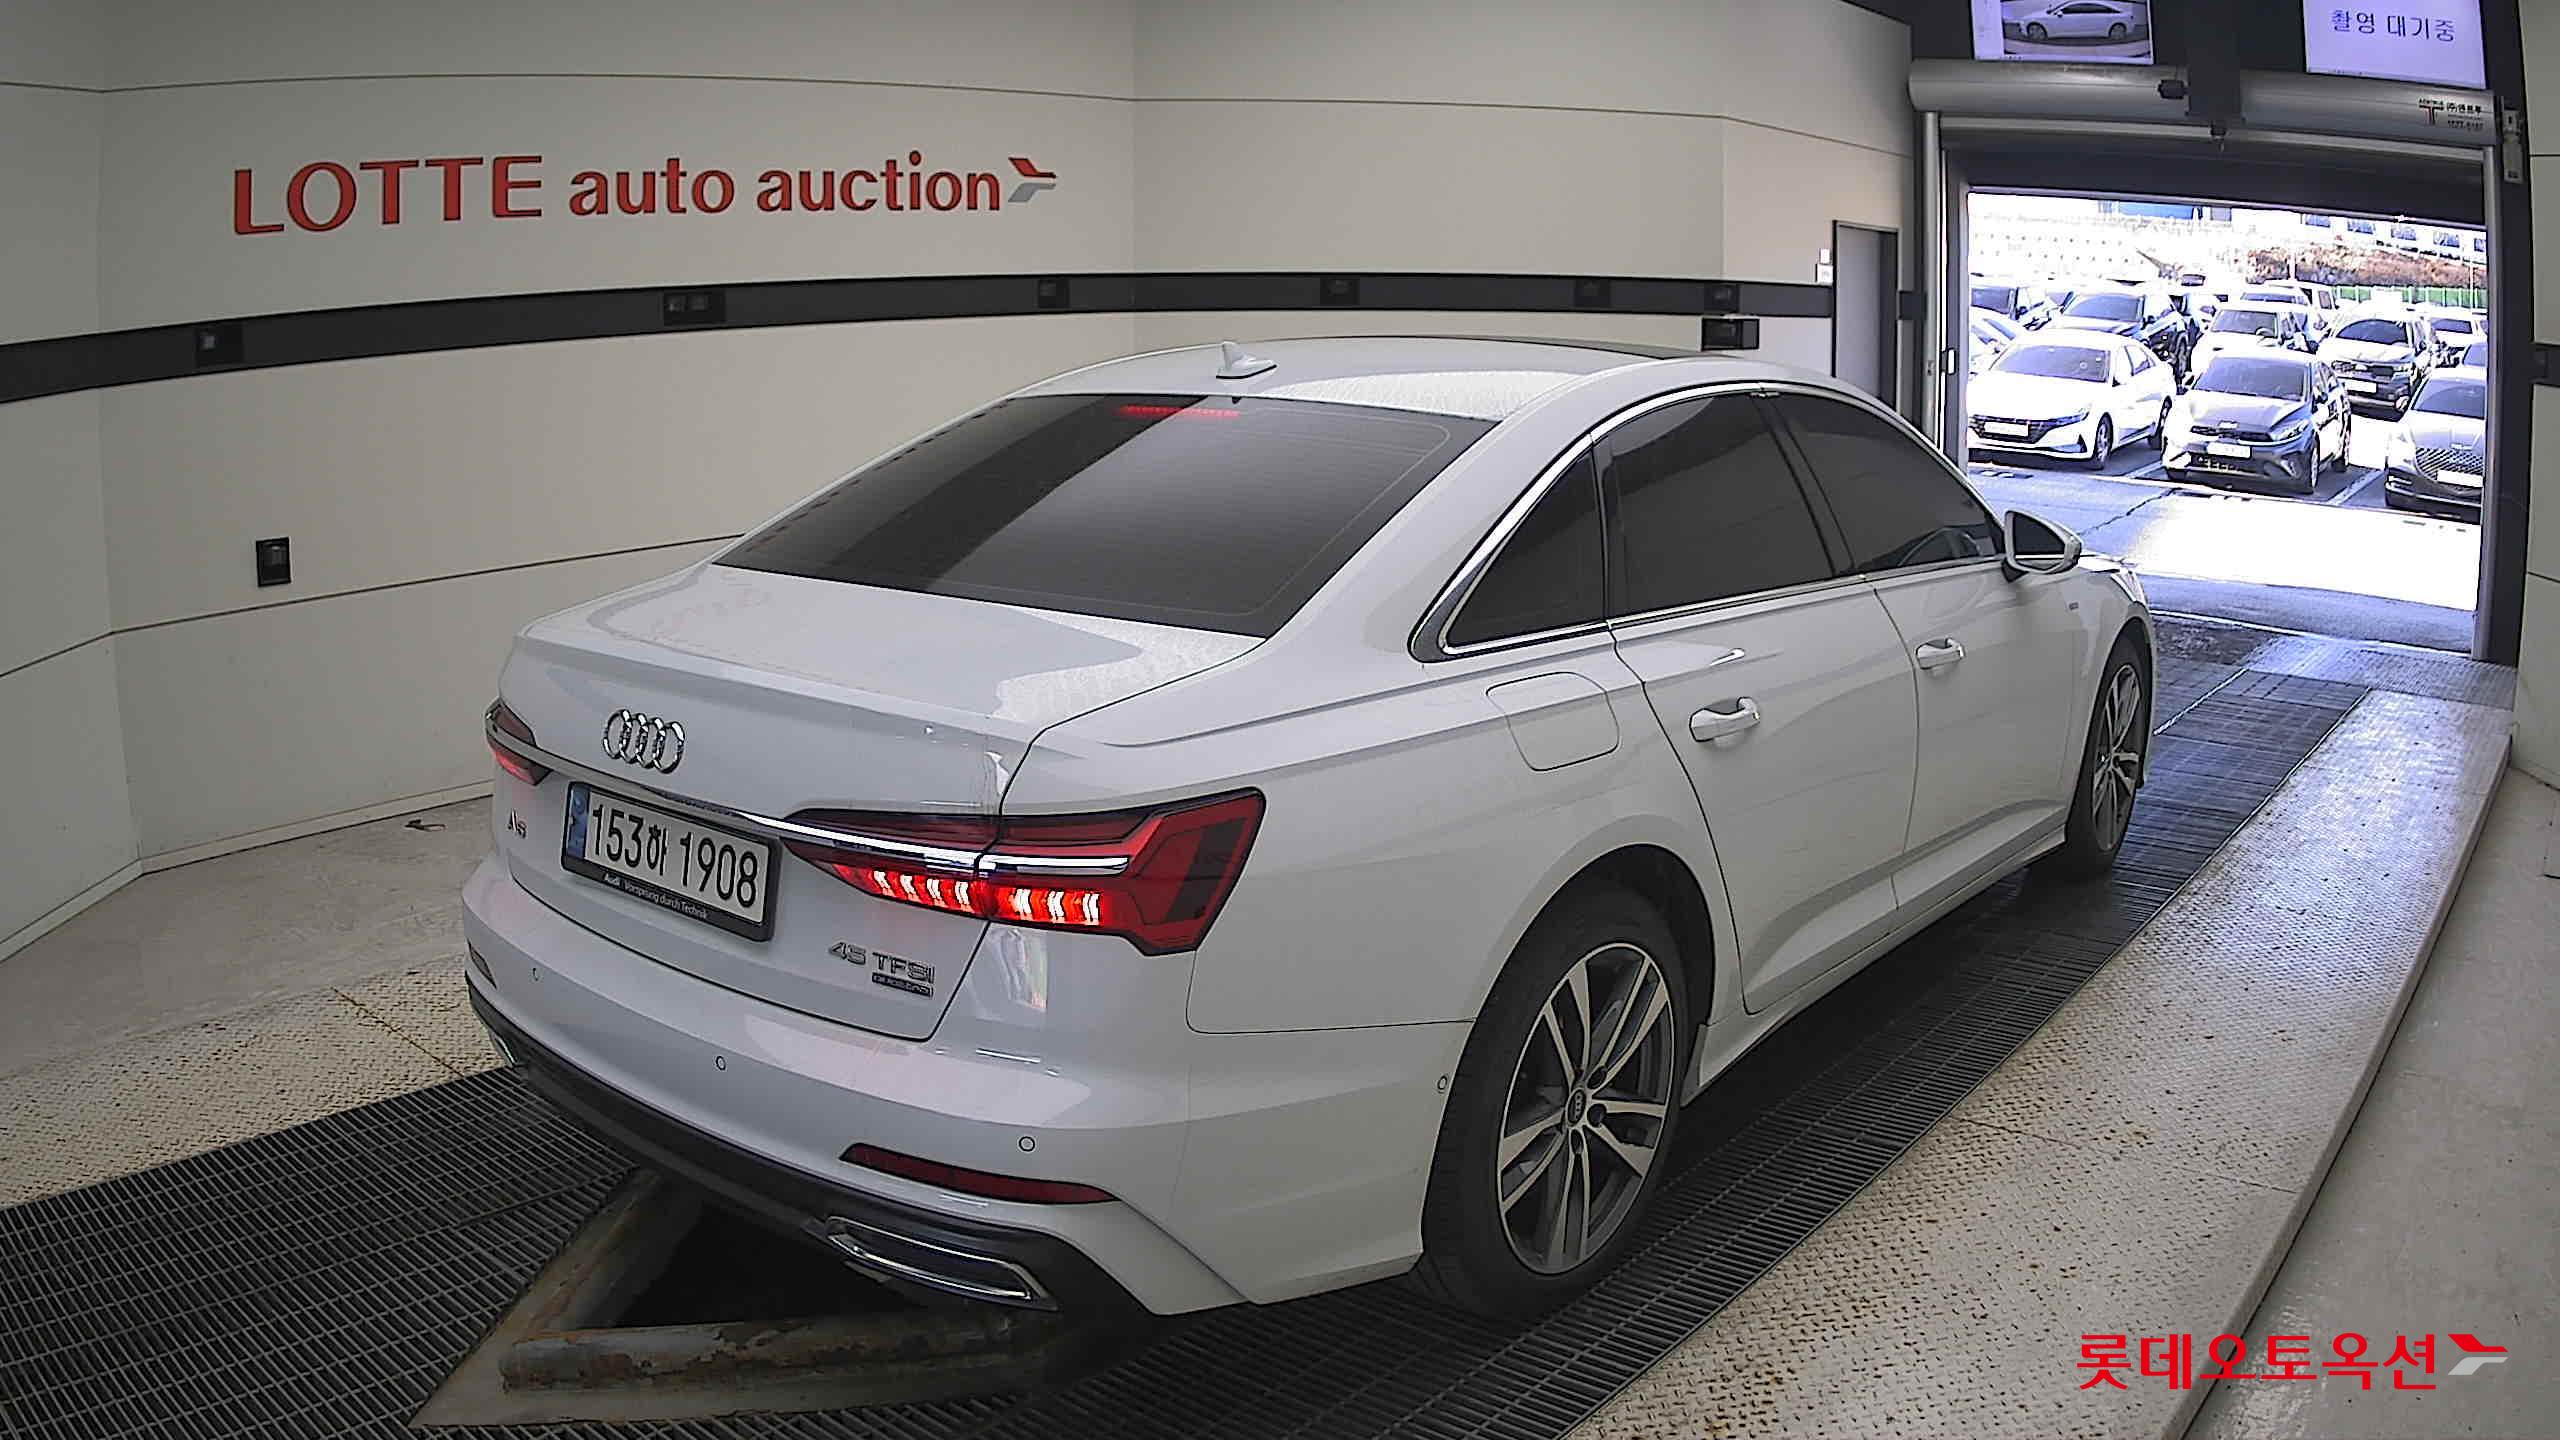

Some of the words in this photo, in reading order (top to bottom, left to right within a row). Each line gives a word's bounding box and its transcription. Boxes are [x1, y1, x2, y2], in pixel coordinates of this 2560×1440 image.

[2332, 9, 2375, 34] 촬영
[2387, 15, 2456, 42] 대기중
[234, 155, 543, 235] LOTTE
[569, 157, 736, 216] auto
[757, 150, 1001, 213] auction
[593, 804, 668, 877] 153하
[680, 831, 758, 908] 1908
[830, 942, 866, 965] 45
[872, 952, 935, 984] TFSI
